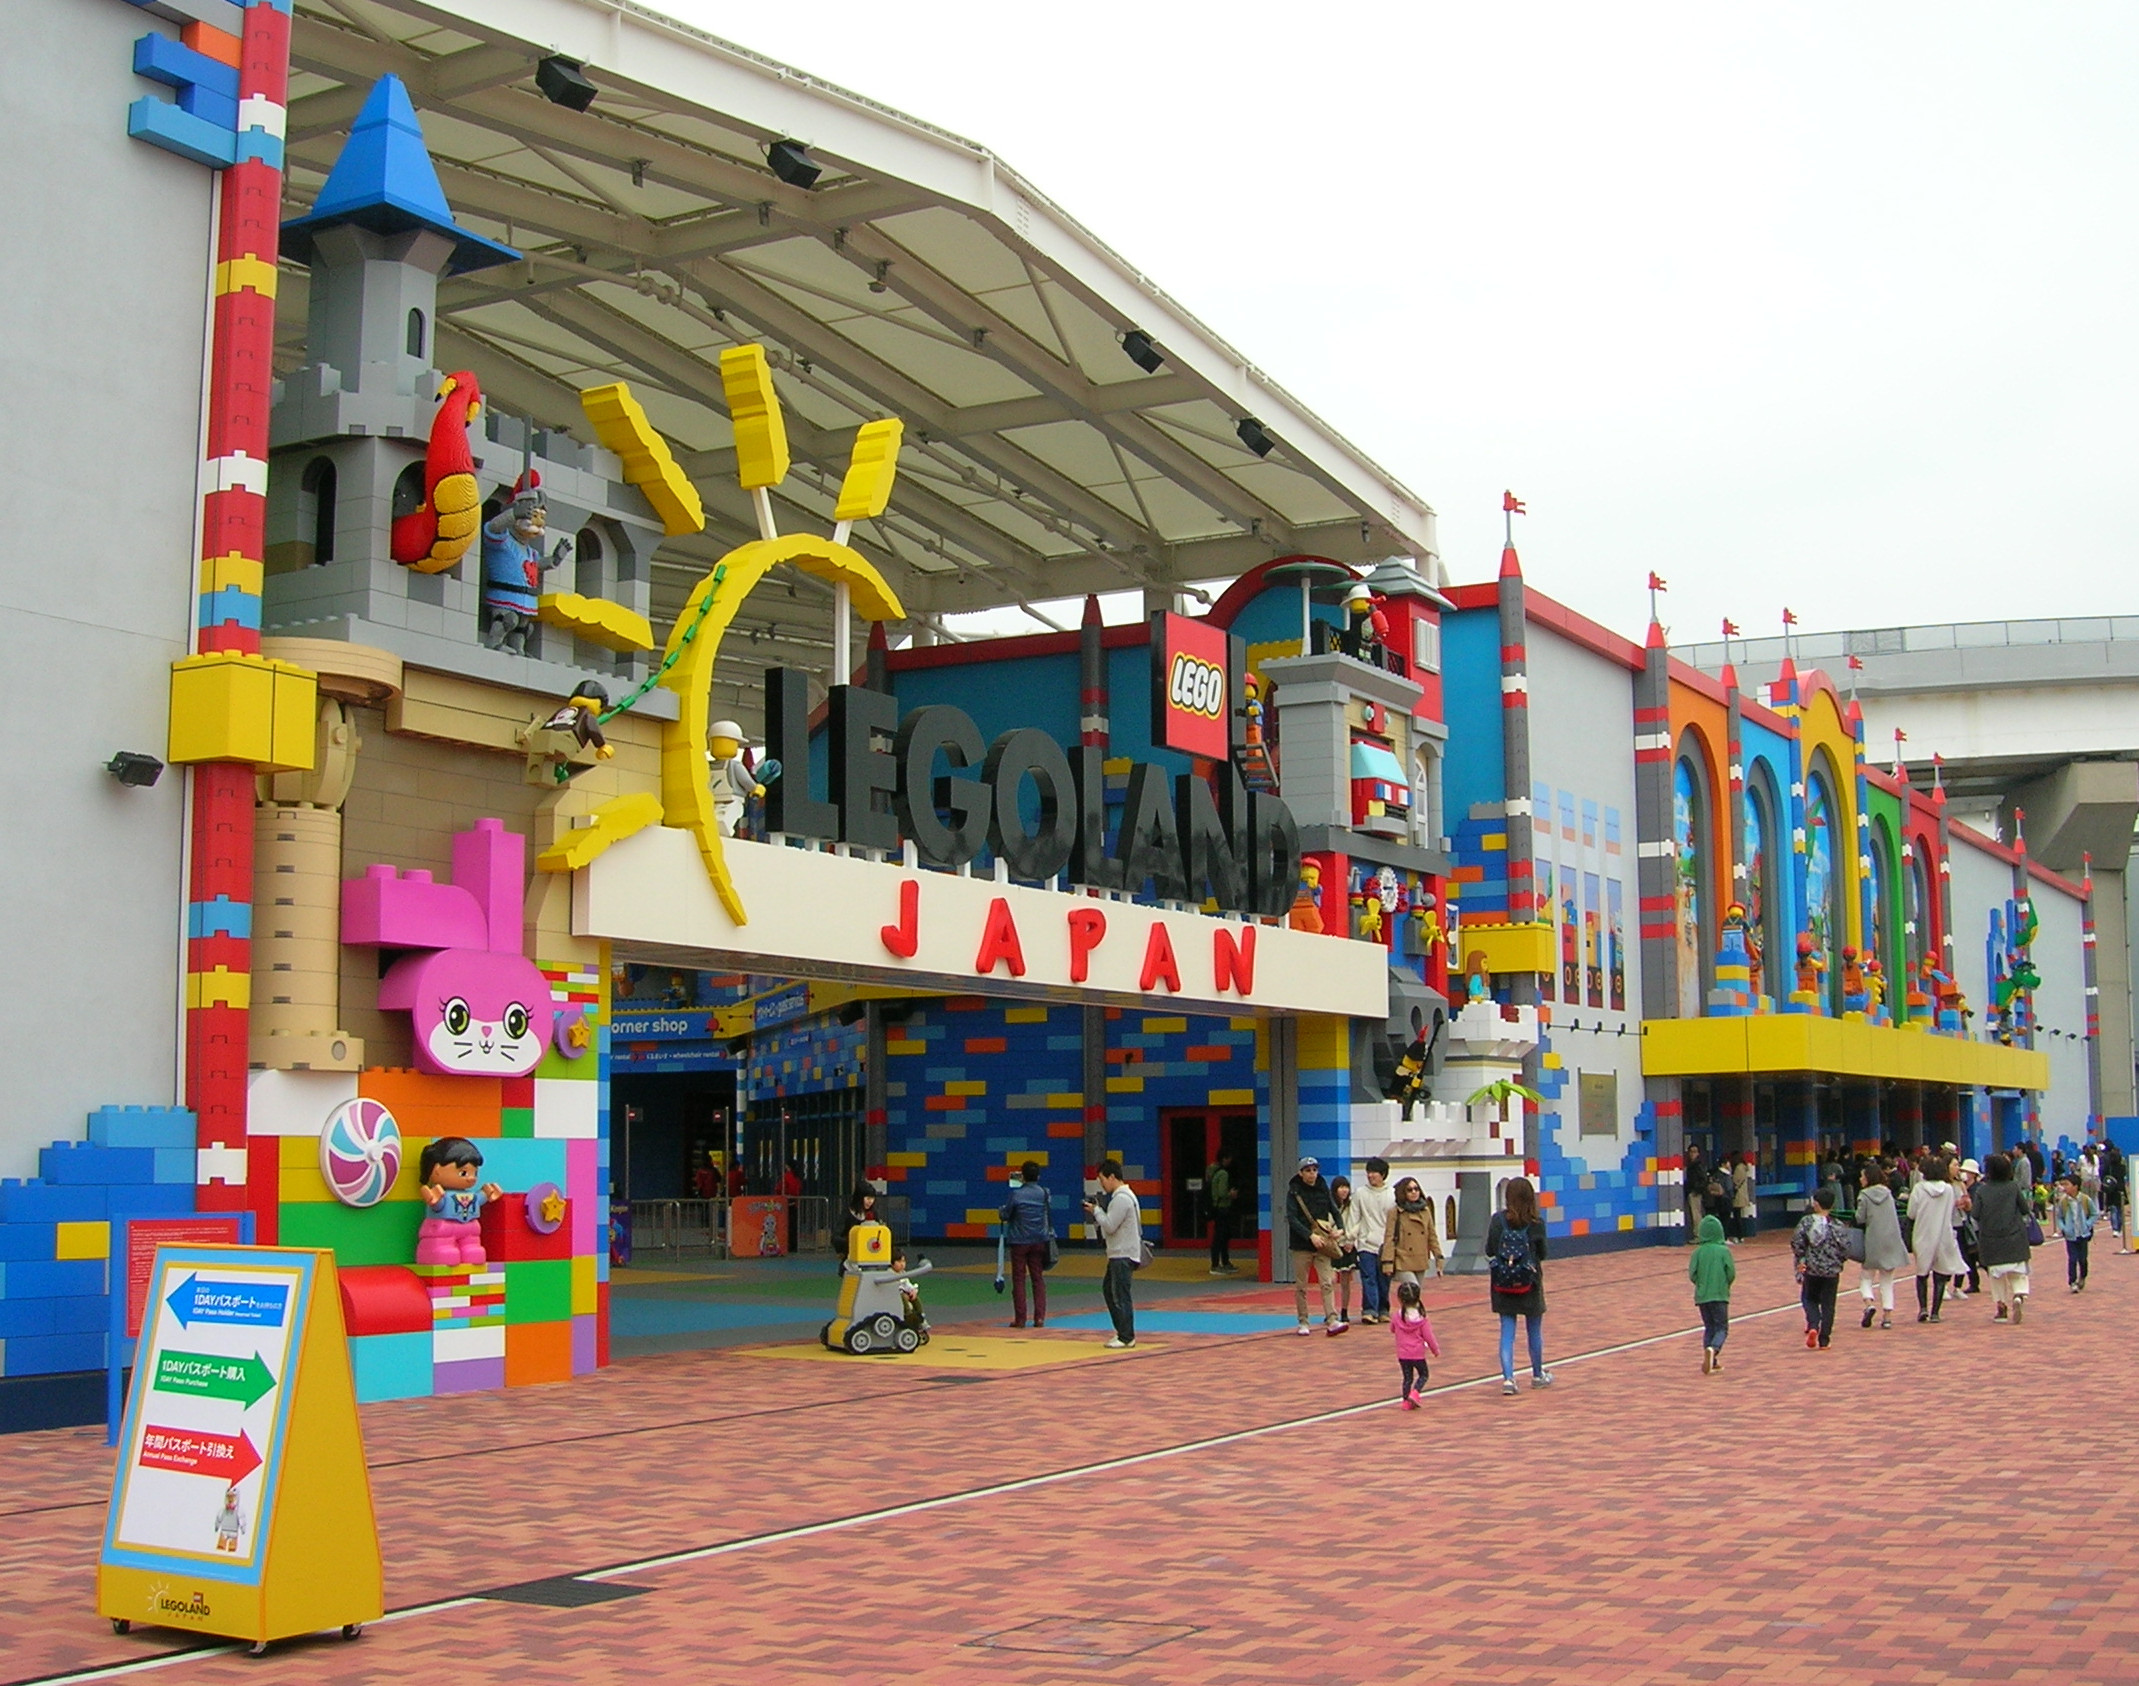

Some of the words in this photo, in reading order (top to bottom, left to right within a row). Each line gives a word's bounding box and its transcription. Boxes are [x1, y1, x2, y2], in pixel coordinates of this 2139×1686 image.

[1170, 656, 1223, 715] LEGO
[764, 660, 1301, 917] LEGOLAND
[880, 879, 1257, 997] JAPAN
[652, 1017, 688, 1035] shop
[205, 1308, 217, 1316] Pass
[218, 1308, 235, 1317] Holder
[162, 1359, 246, 1382] 1DAYパスポート購入
[173, 1376, 185, 1385] Pass
[185, 1378, 209, 1388] Purchase
[145, 1434, 234, 1459] 年間パスポート引換え
[143, 1451, 160, 1459] Annual
[160, 1453, 173, 1461] Pass
[173, 1454, 198, 1467] Exchange
[161, 1597, 211, 1616] LEGOLAND
